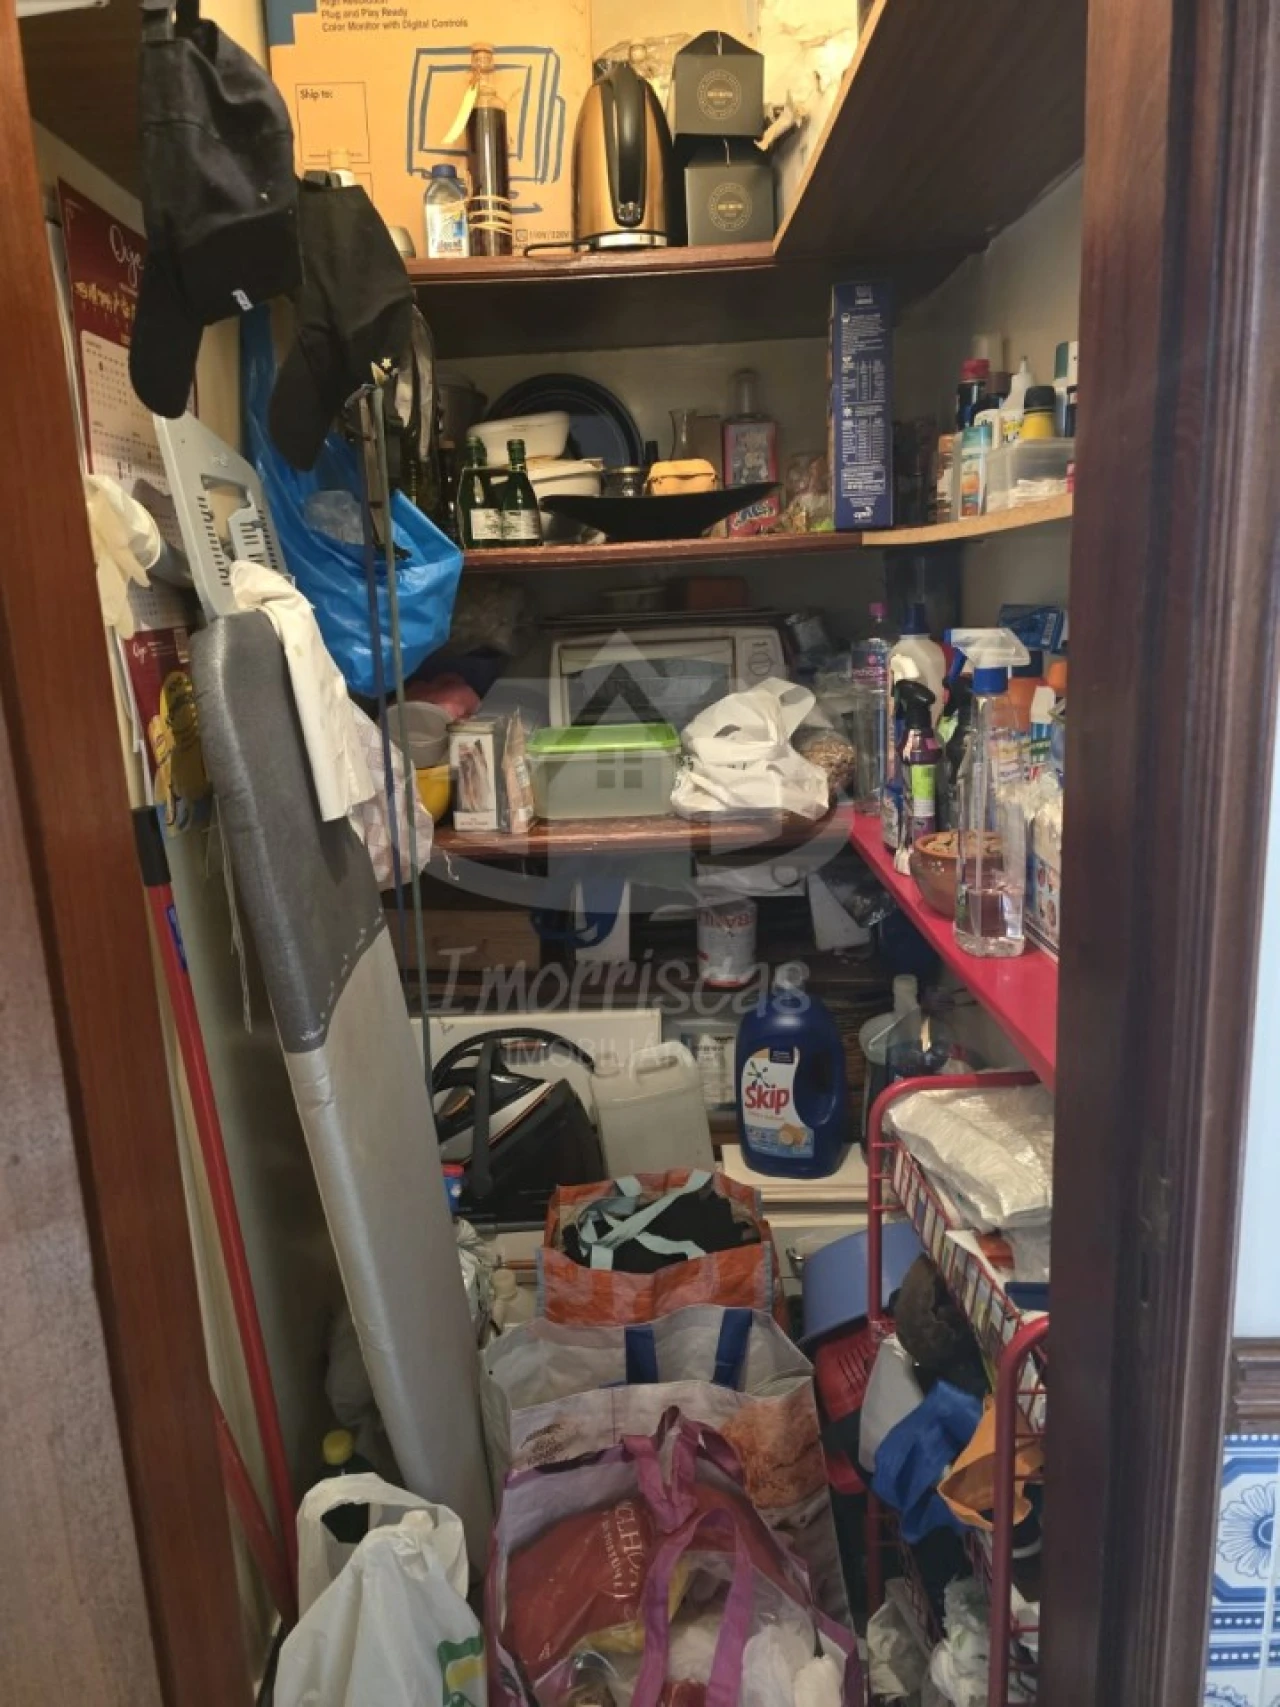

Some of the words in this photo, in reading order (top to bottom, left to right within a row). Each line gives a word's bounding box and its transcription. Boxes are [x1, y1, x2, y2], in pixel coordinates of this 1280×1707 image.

[321, 9, 342, 20] Plug
[343, 9, 360, 19] and
[361, 8, 380, 19] Play
[382, 7, 408, 17] Ready
[321, 22, 346, 33] Color
[347, 21, 380, 31] Monitor
[382, 20, 401, 30] with
[402, 19, 430, 31] Digital
[431, 17, 469, 29] Controls
[299, 89, 320, 101] Ship
[744, 1083, 790, 1116] Skip
